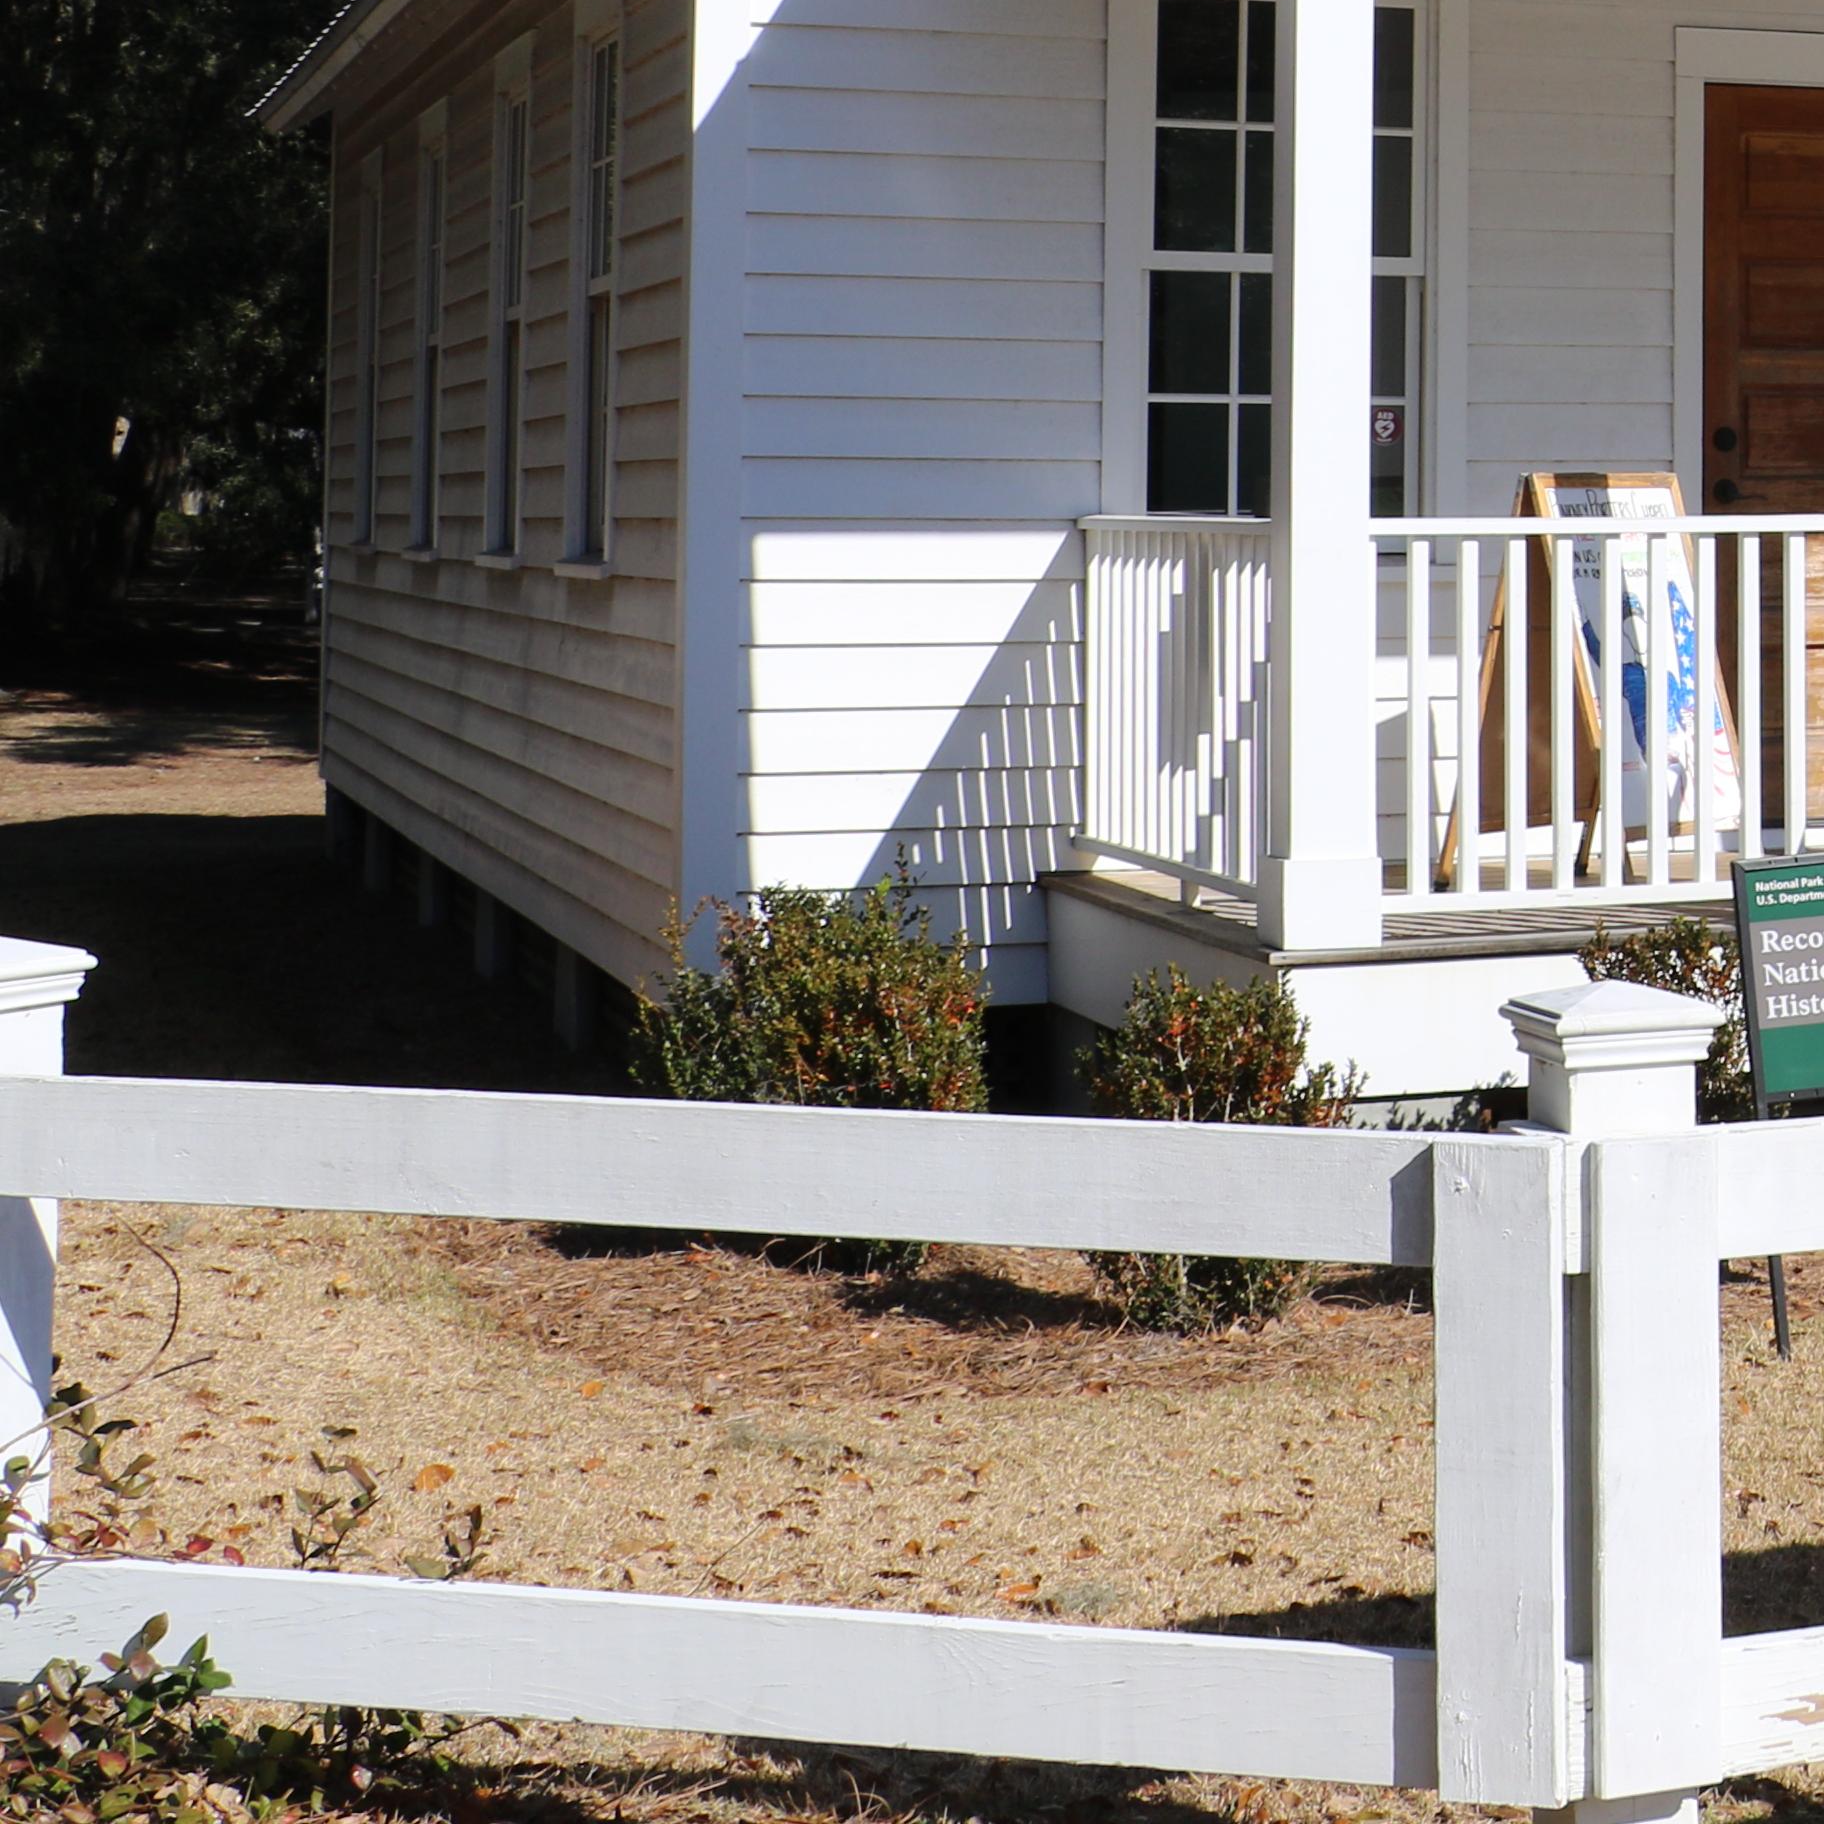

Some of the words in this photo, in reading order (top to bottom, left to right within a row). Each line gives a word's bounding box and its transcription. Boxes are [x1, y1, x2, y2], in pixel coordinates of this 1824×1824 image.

[1755, 878, 1799, 892] National
[1801, 876, 1824, 888] Park
[1757, 894, 1777, 906] U.S.
